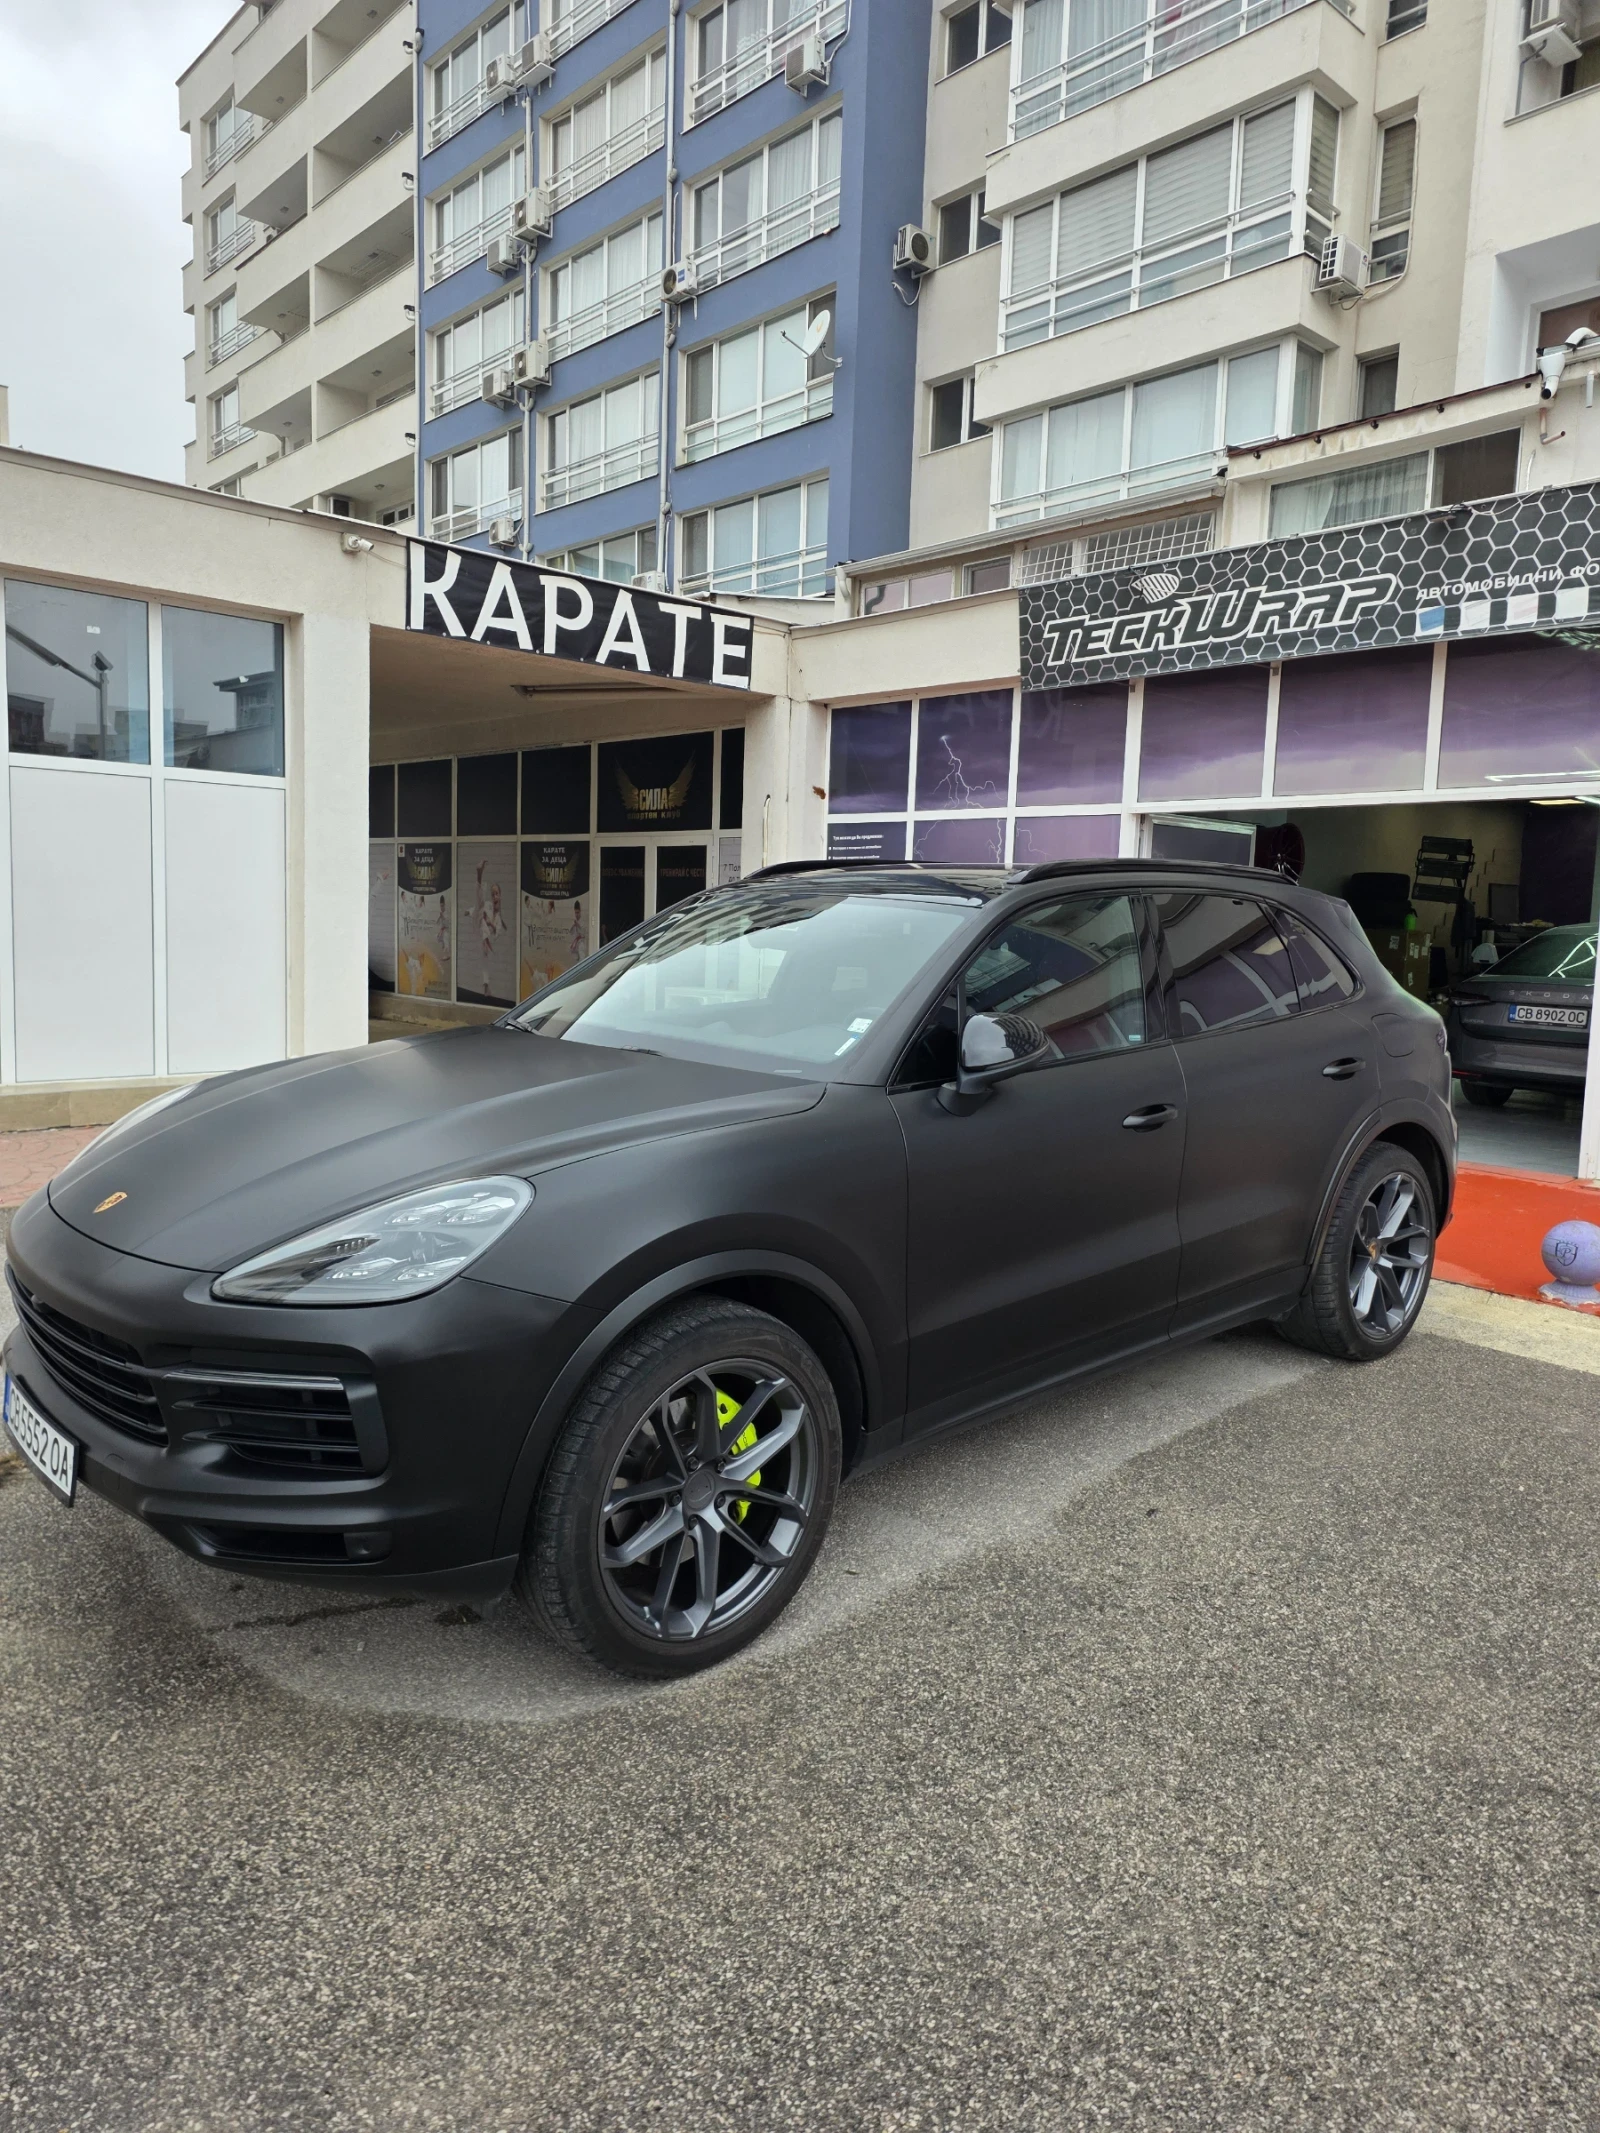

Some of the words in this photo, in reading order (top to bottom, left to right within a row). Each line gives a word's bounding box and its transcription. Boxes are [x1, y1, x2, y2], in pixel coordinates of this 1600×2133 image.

[1416, 568, 1562, 601] АВТОМОБИЛНИ
[409, 540, 750, 689] КАРАТЕ
[639, 787, 668, 811] СИЛА
[1517, 1007, 1533, 1020] CB
[1535, 1009, 1566, 1023] 8902
[1567, 1011, 1585, 1024] OC
[20, 1403, 49, 1468] 5552
